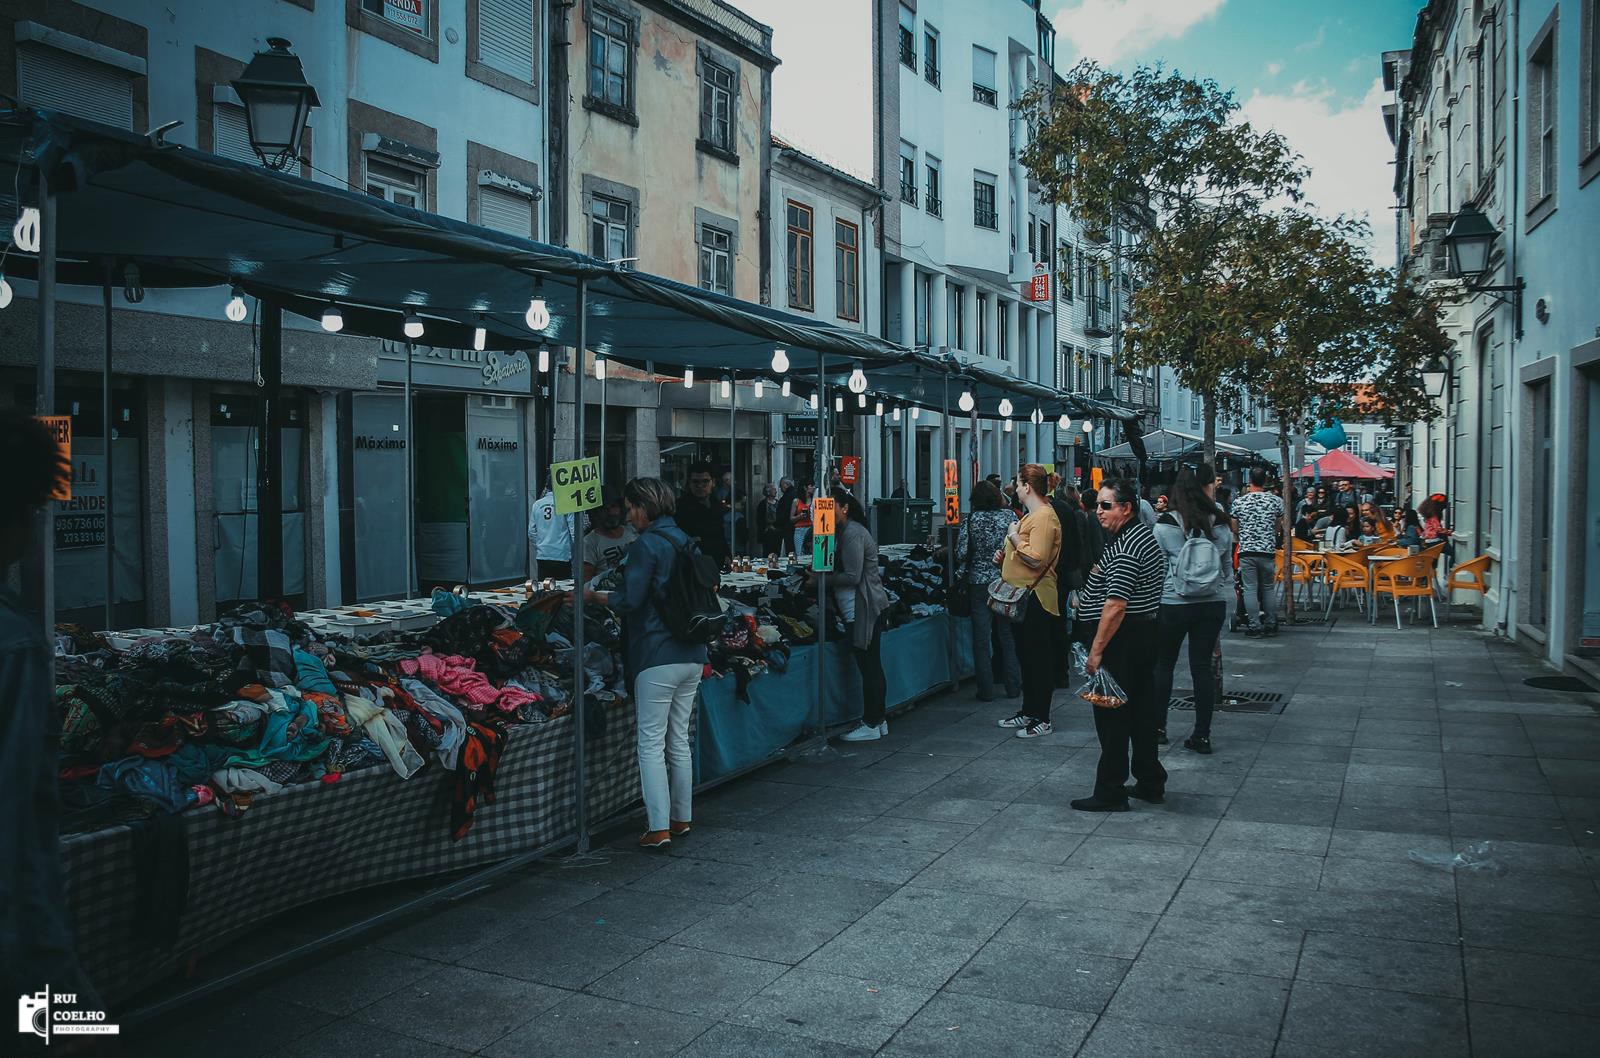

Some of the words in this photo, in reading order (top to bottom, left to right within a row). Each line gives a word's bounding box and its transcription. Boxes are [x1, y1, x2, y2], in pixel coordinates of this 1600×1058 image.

[482, 351, 527, 385] Sapataria
[355, 436, 407, 450] Máxima
[478, 437, 518, 450] Máxima
[556, 463, 598, 486] CADA
[571, 487, 597, 506] 1€
[544, 507, 552, 520] 3
[93, 518, 105, 528] 06
